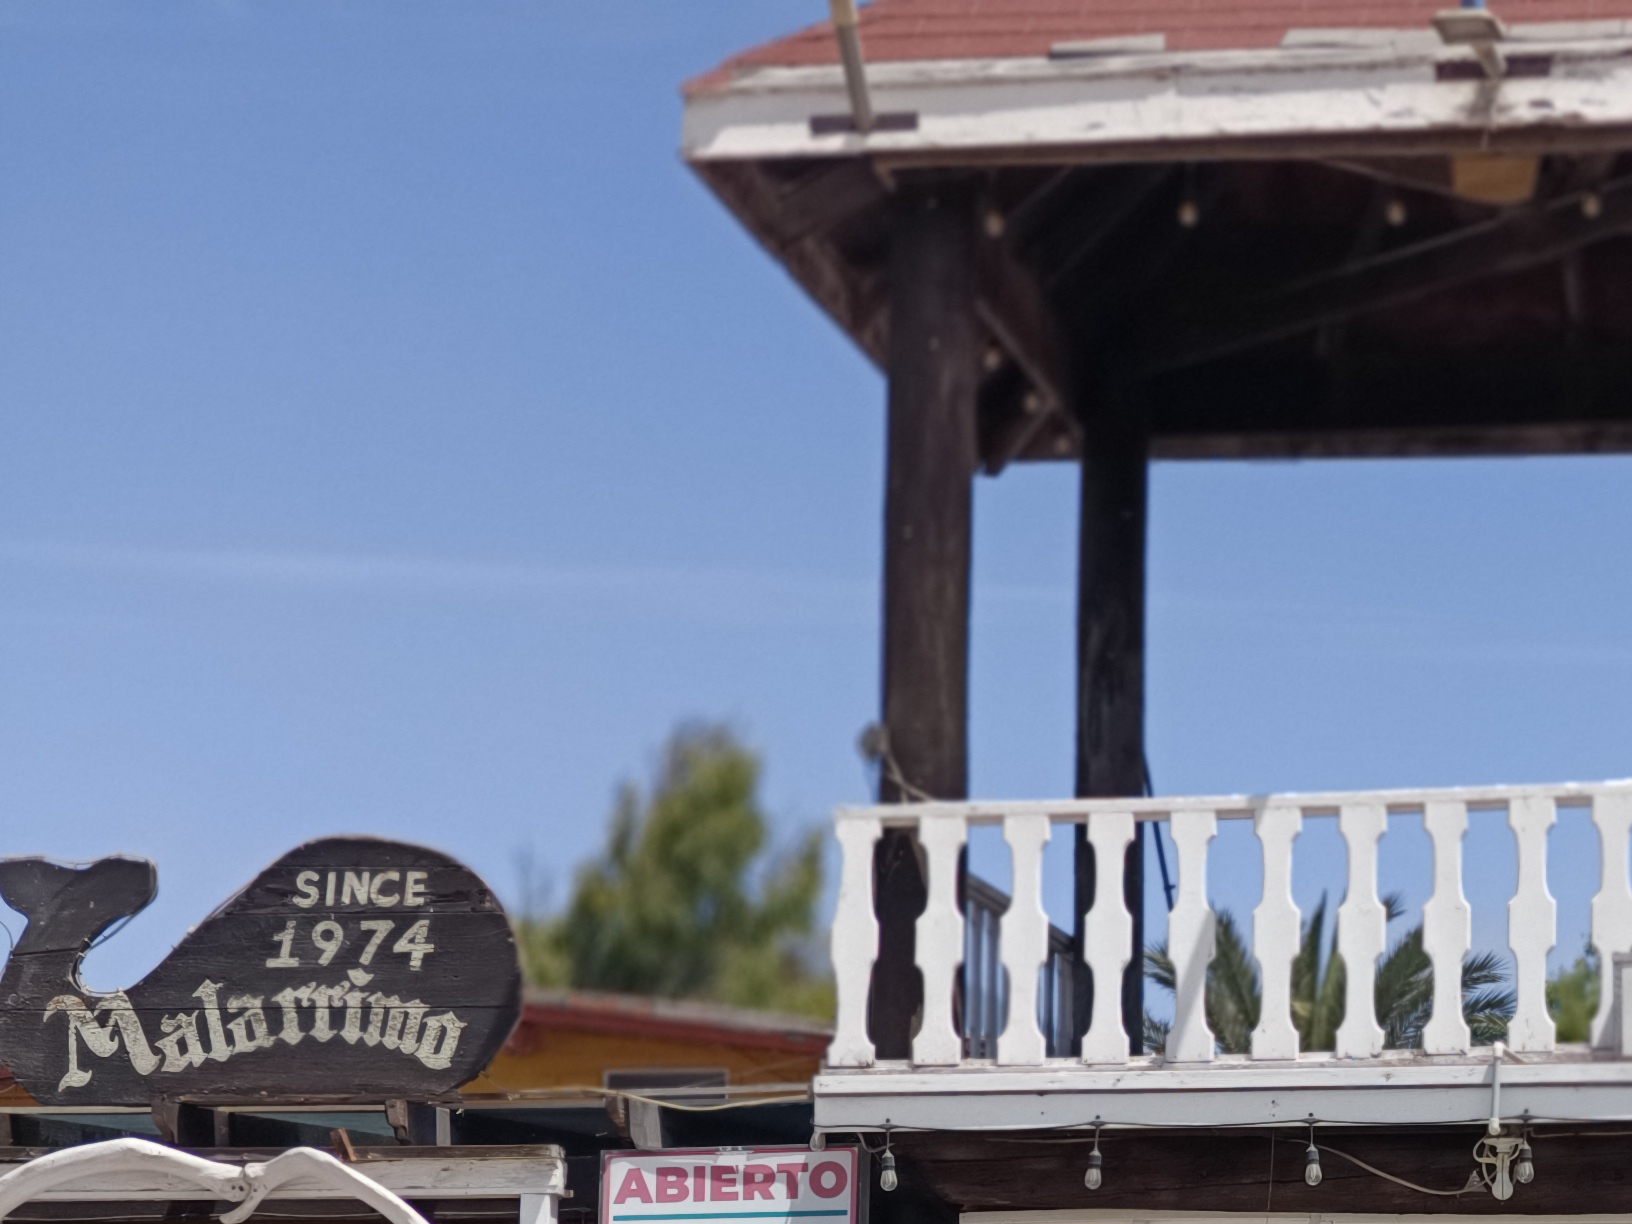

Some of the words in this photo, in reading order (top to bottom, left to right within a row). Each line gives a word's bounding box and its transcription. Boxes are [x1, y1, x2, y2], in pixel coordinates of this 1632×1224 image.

[292, 870, 429, 909] SINCE
[265, 919, 436, 971] 1974
[43, 968, 468, 1092] Malarrimo
[613, 1161, 848, 1205] ABIERTO
